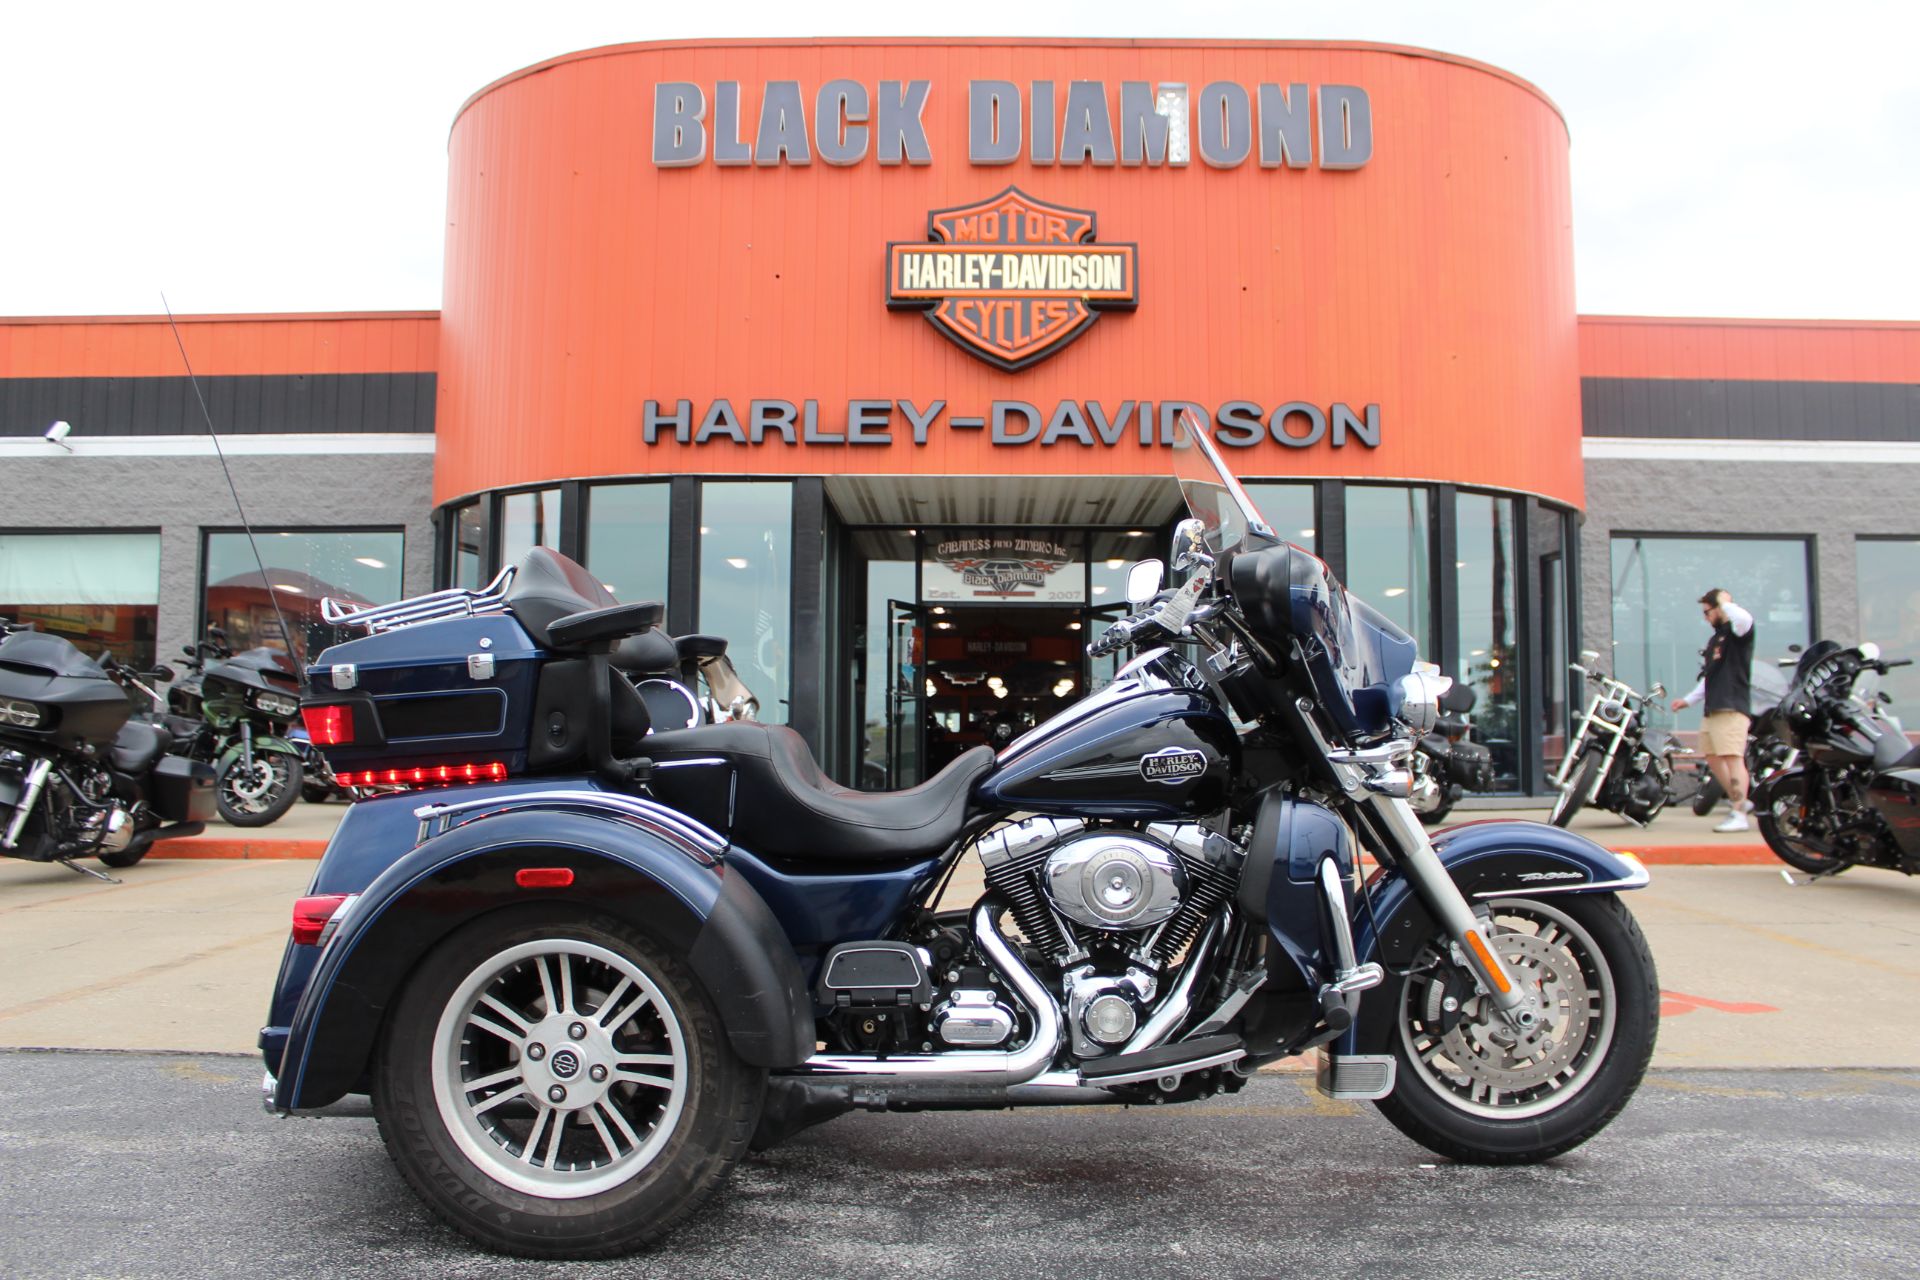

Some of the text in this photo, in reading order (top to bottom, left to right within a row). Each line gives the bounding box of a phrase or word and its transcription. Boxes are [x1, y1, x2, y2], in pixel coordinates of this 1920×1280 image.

[652, 79, 1374, 170] BLACK DIAMOND
[955, 203, 1070, 242] MOTOR
[903, 254, 1121, 290] HARLEY-DAVIDSON
[955, 300, 1069, 350] CYCLES
[643, 399, 1381, 449] HARLEY-DAVIDSON
[938, 538, 991, 555] CABANESS
[1015, 539, 1052, 554] ZIMBRO
[1049, 591, 1081, 600] 2007
[1146, 762, 1202, 775] DAVIDSON
[1149, 755, 1199, 767] HARLEY-
